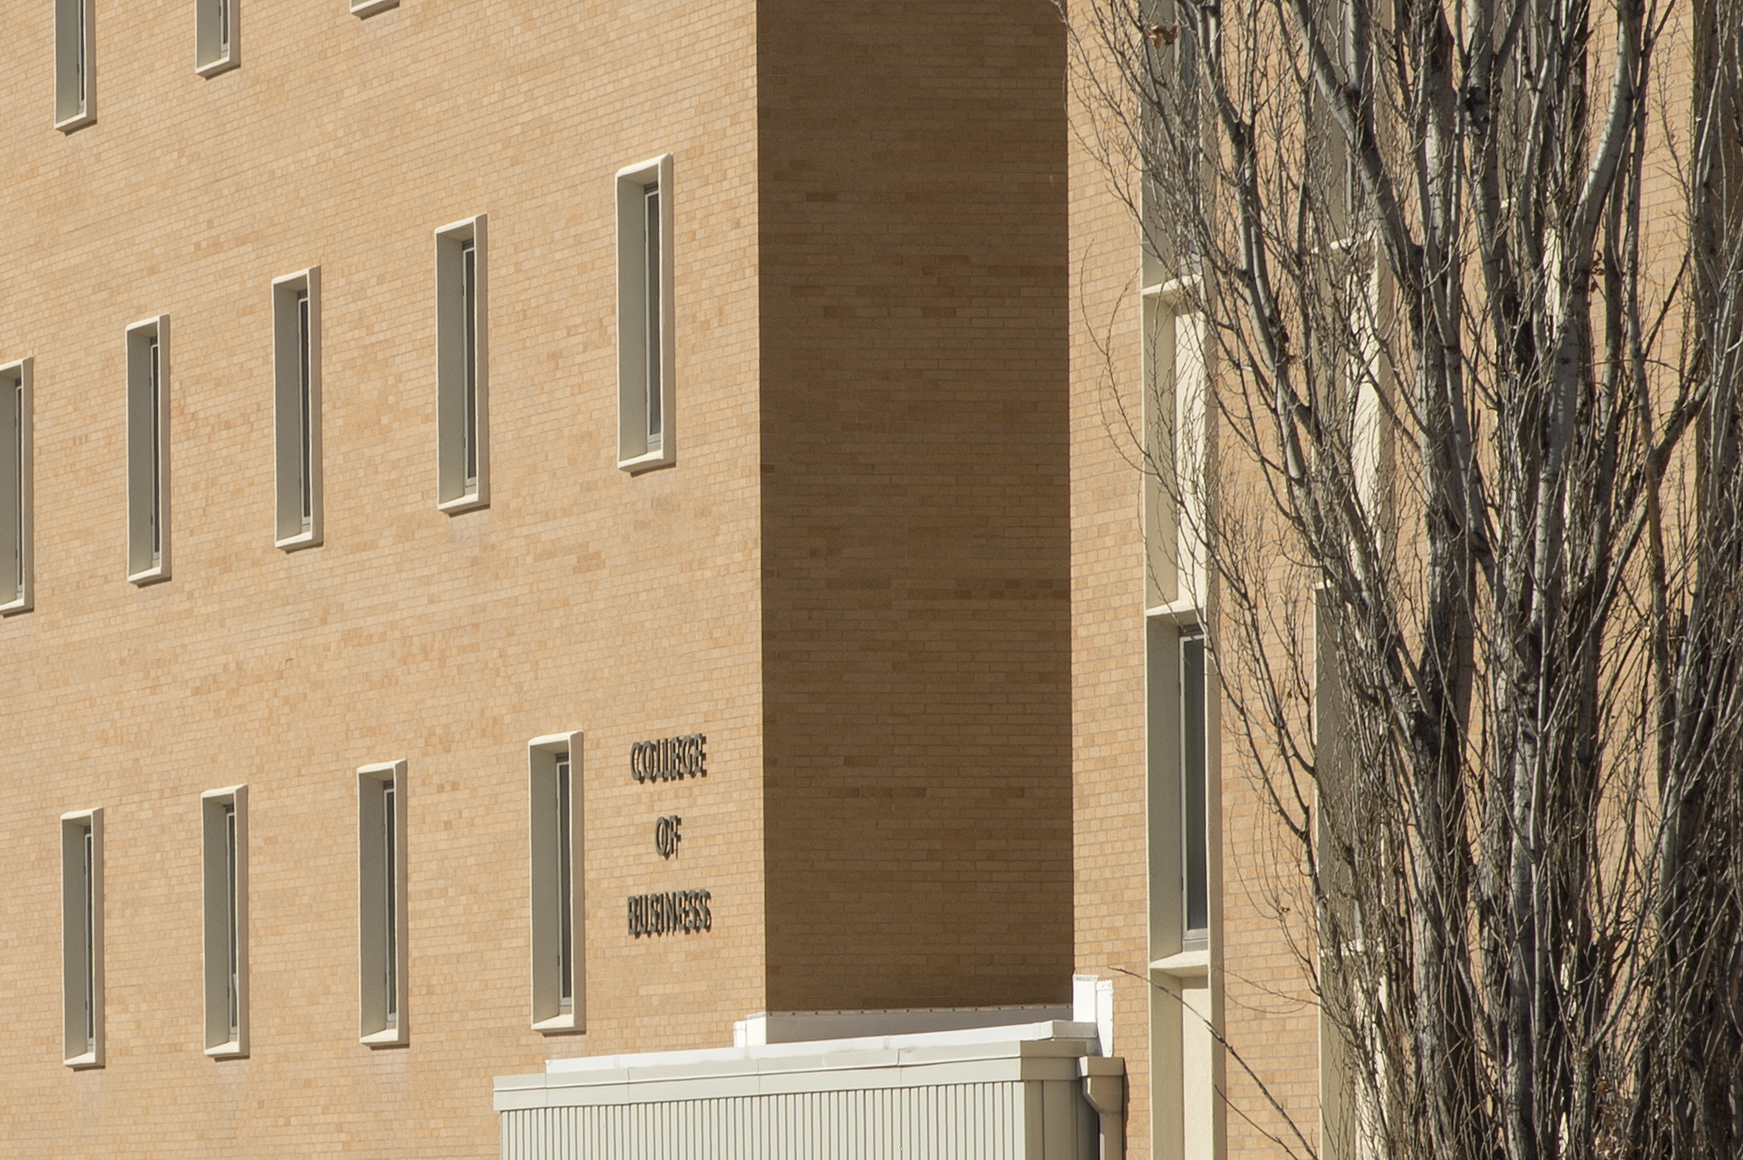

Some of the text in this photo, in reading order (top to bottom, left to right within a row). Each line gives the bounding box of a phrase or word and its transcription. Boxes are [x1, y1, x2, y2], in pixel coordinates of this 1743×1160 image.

[631, 733, 706, 783] COLLEGE
[656, 815, 681, 858] OF
[628, 889, 711, 938] BUSINESS
